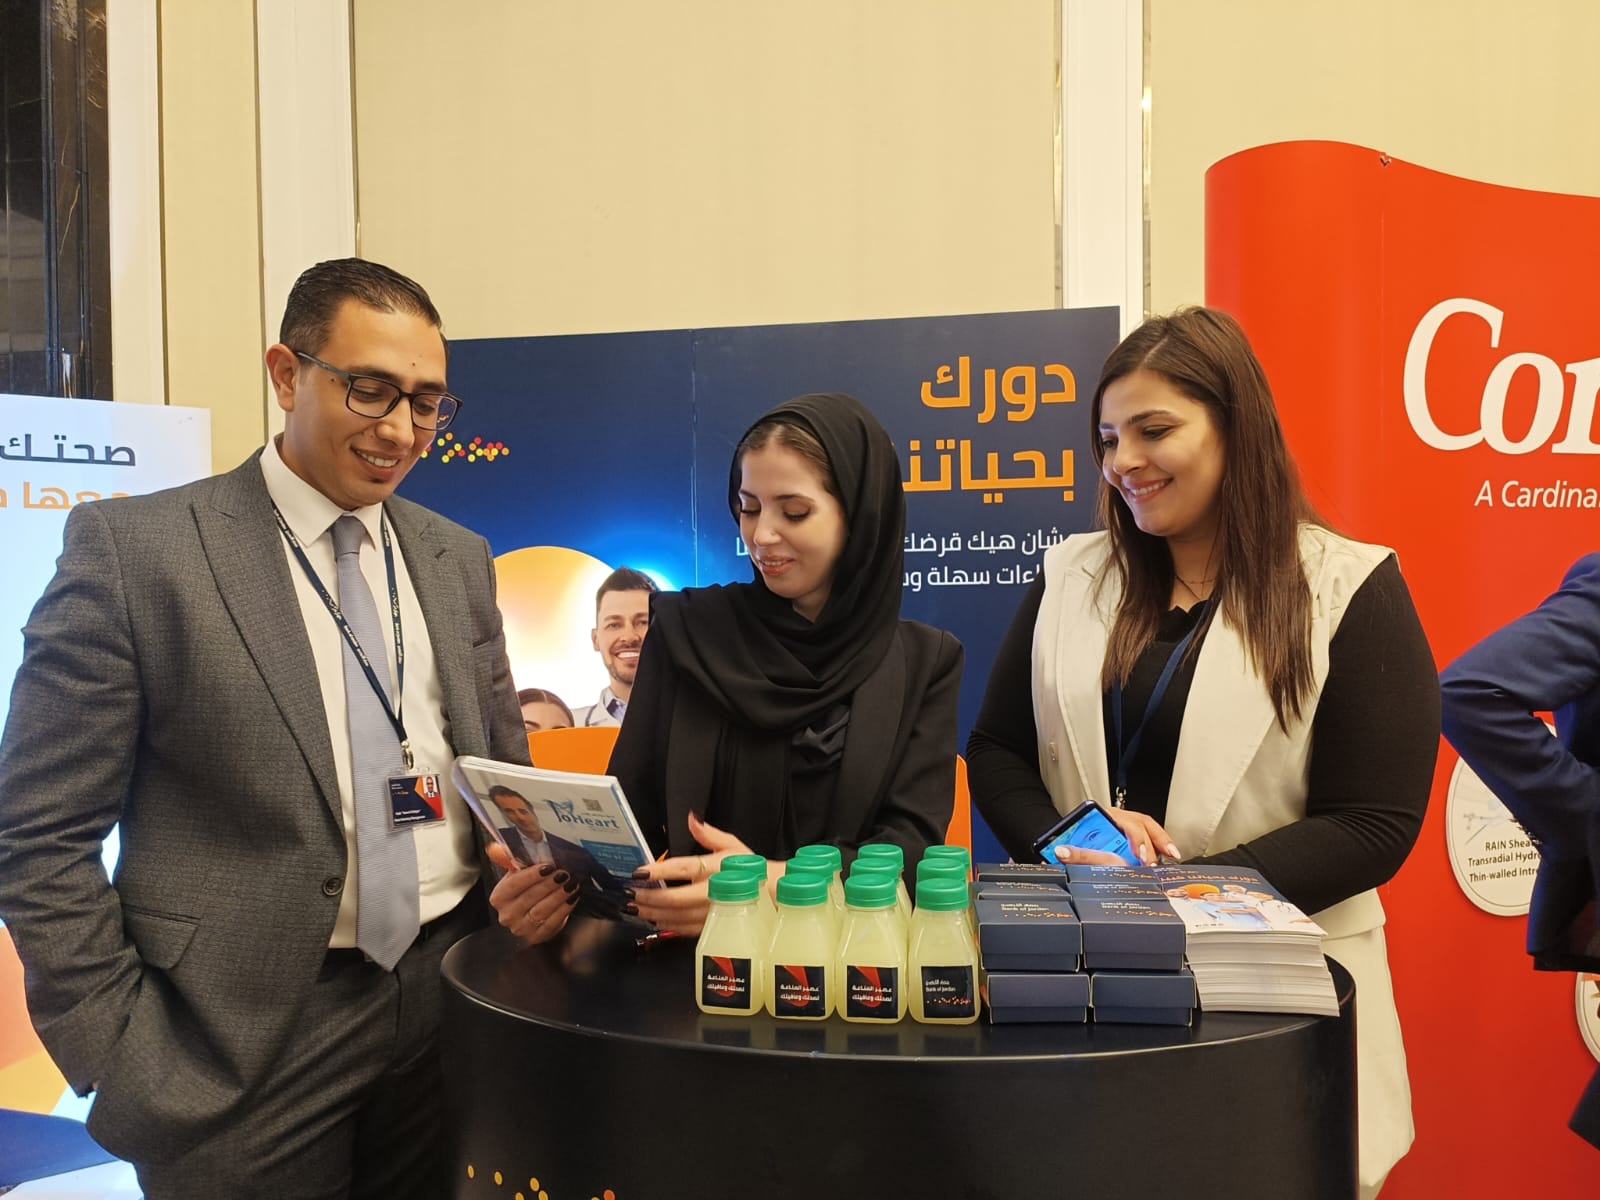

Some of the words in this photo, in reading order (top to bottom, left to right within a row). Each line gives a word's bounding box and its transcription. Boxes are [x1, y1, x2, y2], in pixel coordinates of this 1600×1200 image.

[920, 355, 1077, 424] دورك
[0, 433, 136, 466] صحتك
[902, 439, 1074, 504] بحياتن
[1474, 480, 1493, 507] A
[1502, 480, 1600, 508] Cardina
[903, 532, 962, 557] قرضك
[967, 530, 1016, 554] هيك
[1021, 527, 1064, 555] شان
[927, 566, 990, 586] سهلة
[1485, 840, 1507, 851] RAIN
[1508, 839, 1531, 849] Shea
[1468, 851, 1514, 867] Transradial
[1469, 867, 1518, 882] Thin-walled
[1519, 867, 1537, 877] Intr
